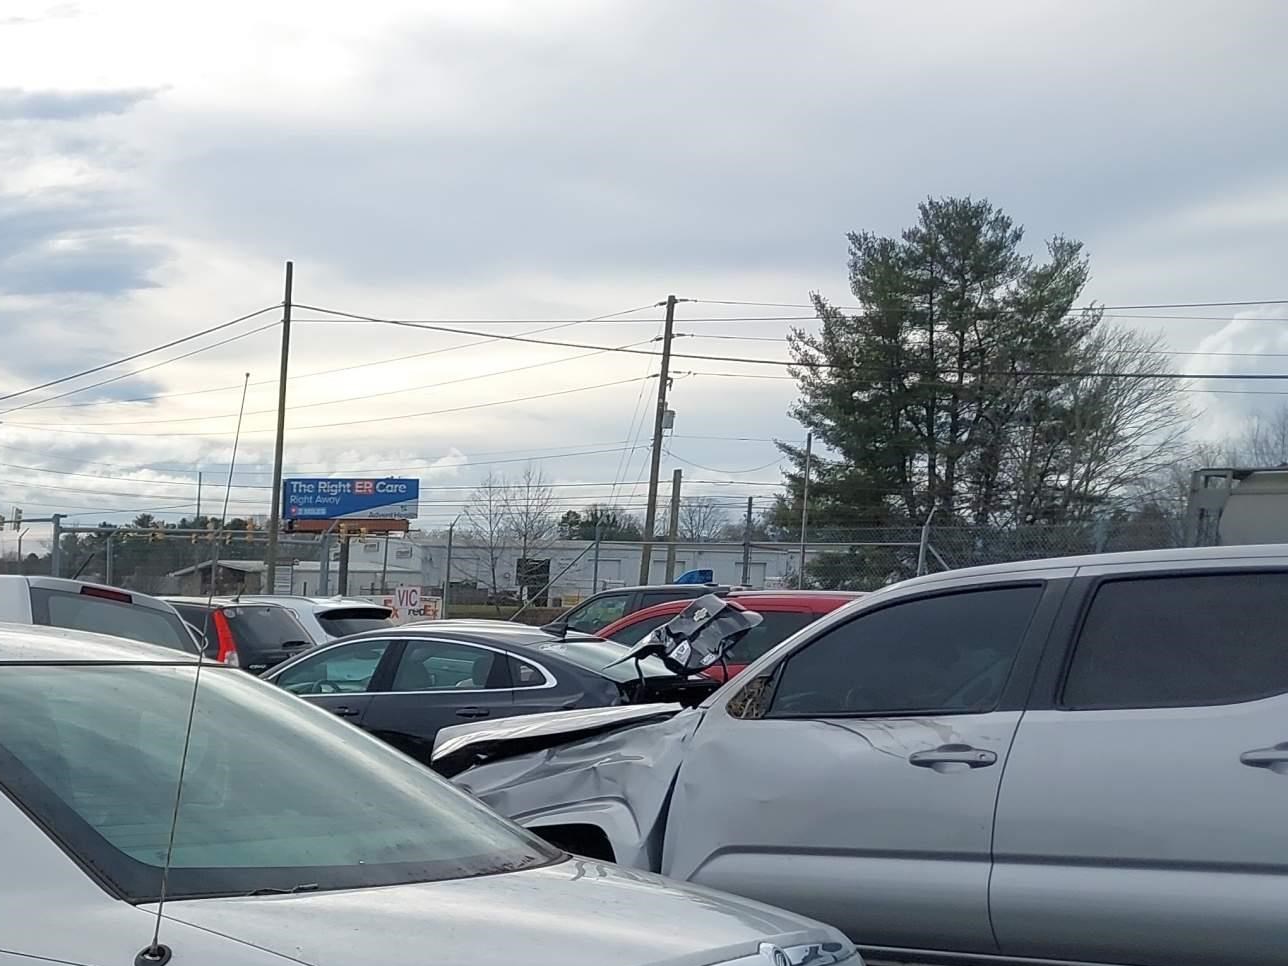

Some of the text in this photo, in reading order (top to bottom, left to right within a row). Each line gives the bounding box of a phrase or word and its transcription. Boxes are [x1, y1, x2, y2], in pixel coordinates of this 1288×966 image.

[291, 481, 407, 495] The Right ER Care
[290, 495, 341, 505] Right Away
[398, 589, 418, 607] VIC
